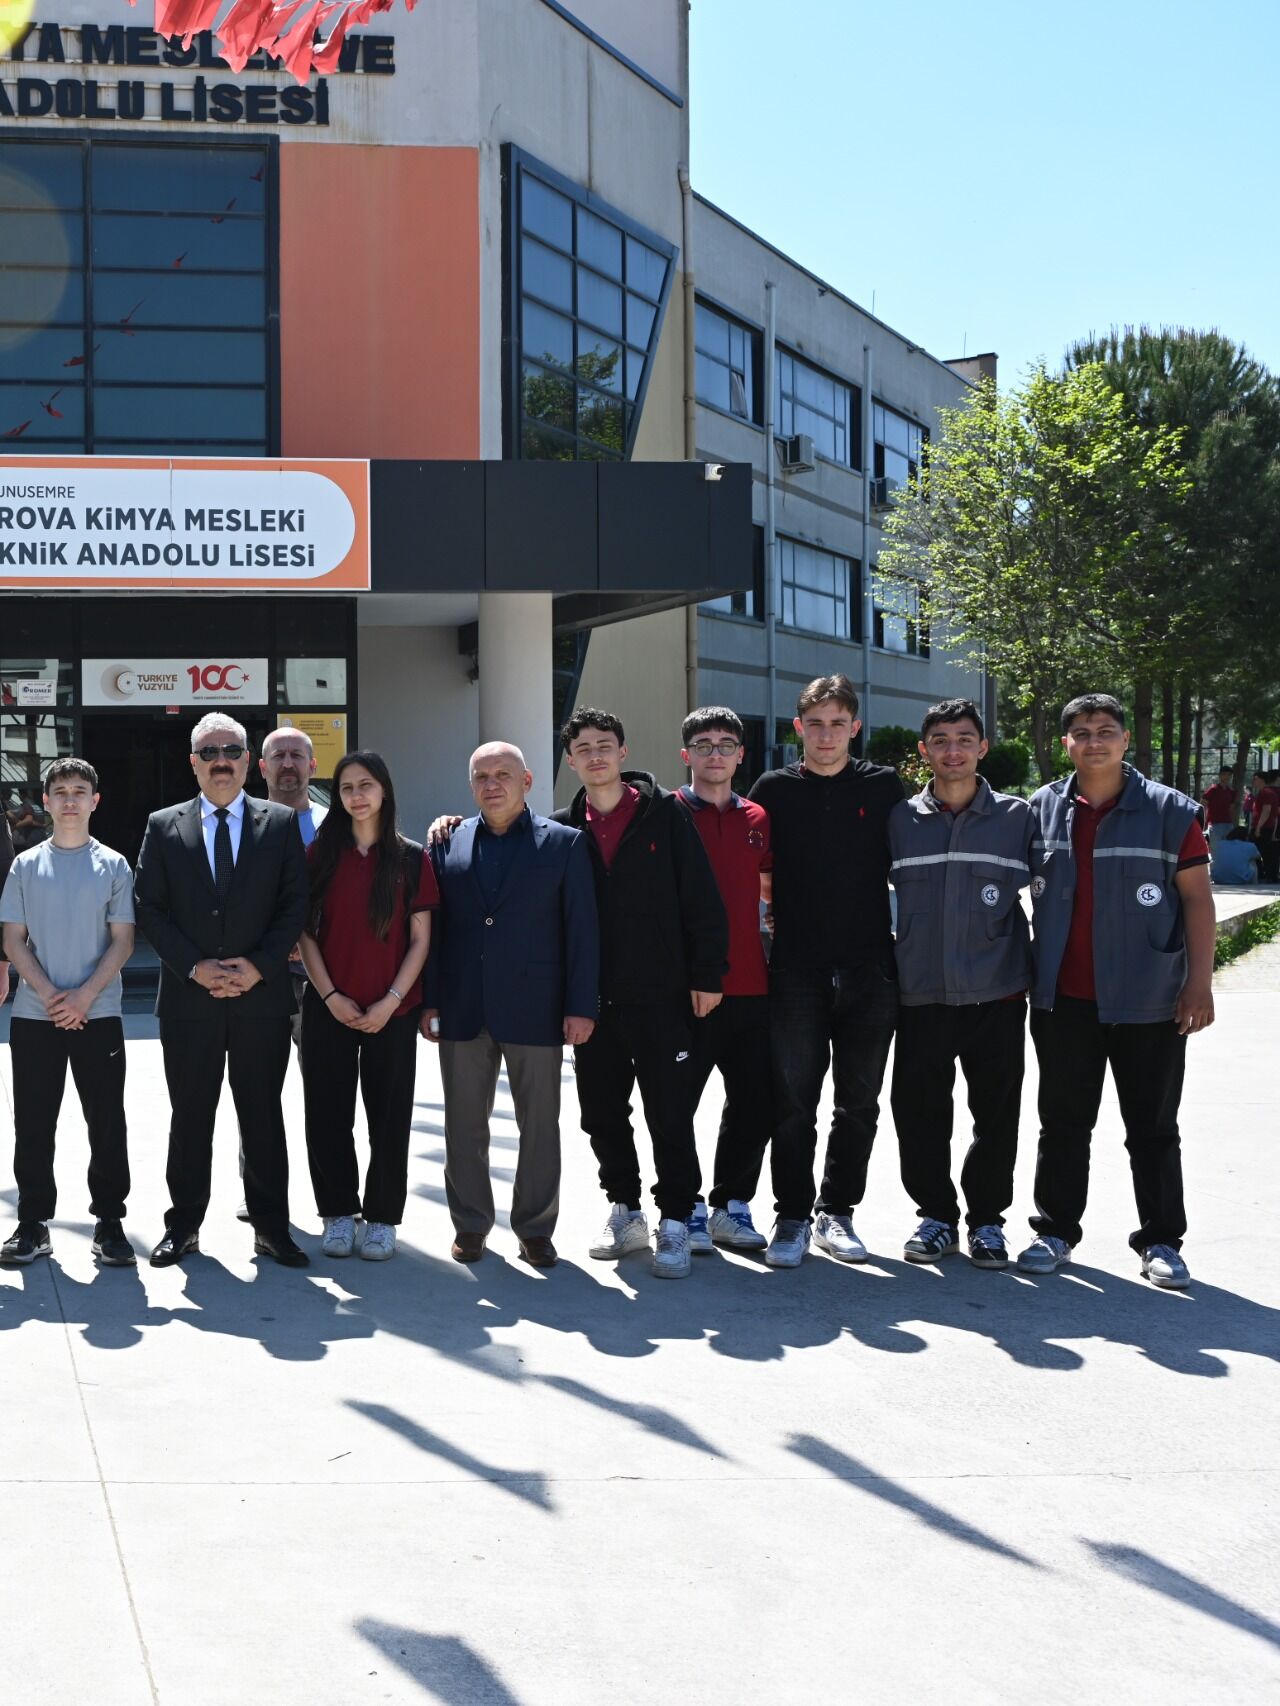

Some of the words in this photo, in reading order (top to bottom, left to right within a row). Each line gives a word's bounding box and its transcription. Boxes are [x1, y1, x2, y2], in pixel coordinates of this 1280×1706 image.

[81, 24, 323, 74] MESL
[161, 76, 329, 125] LİSESİ
[76, 543, 220, 567] ANADOLU
